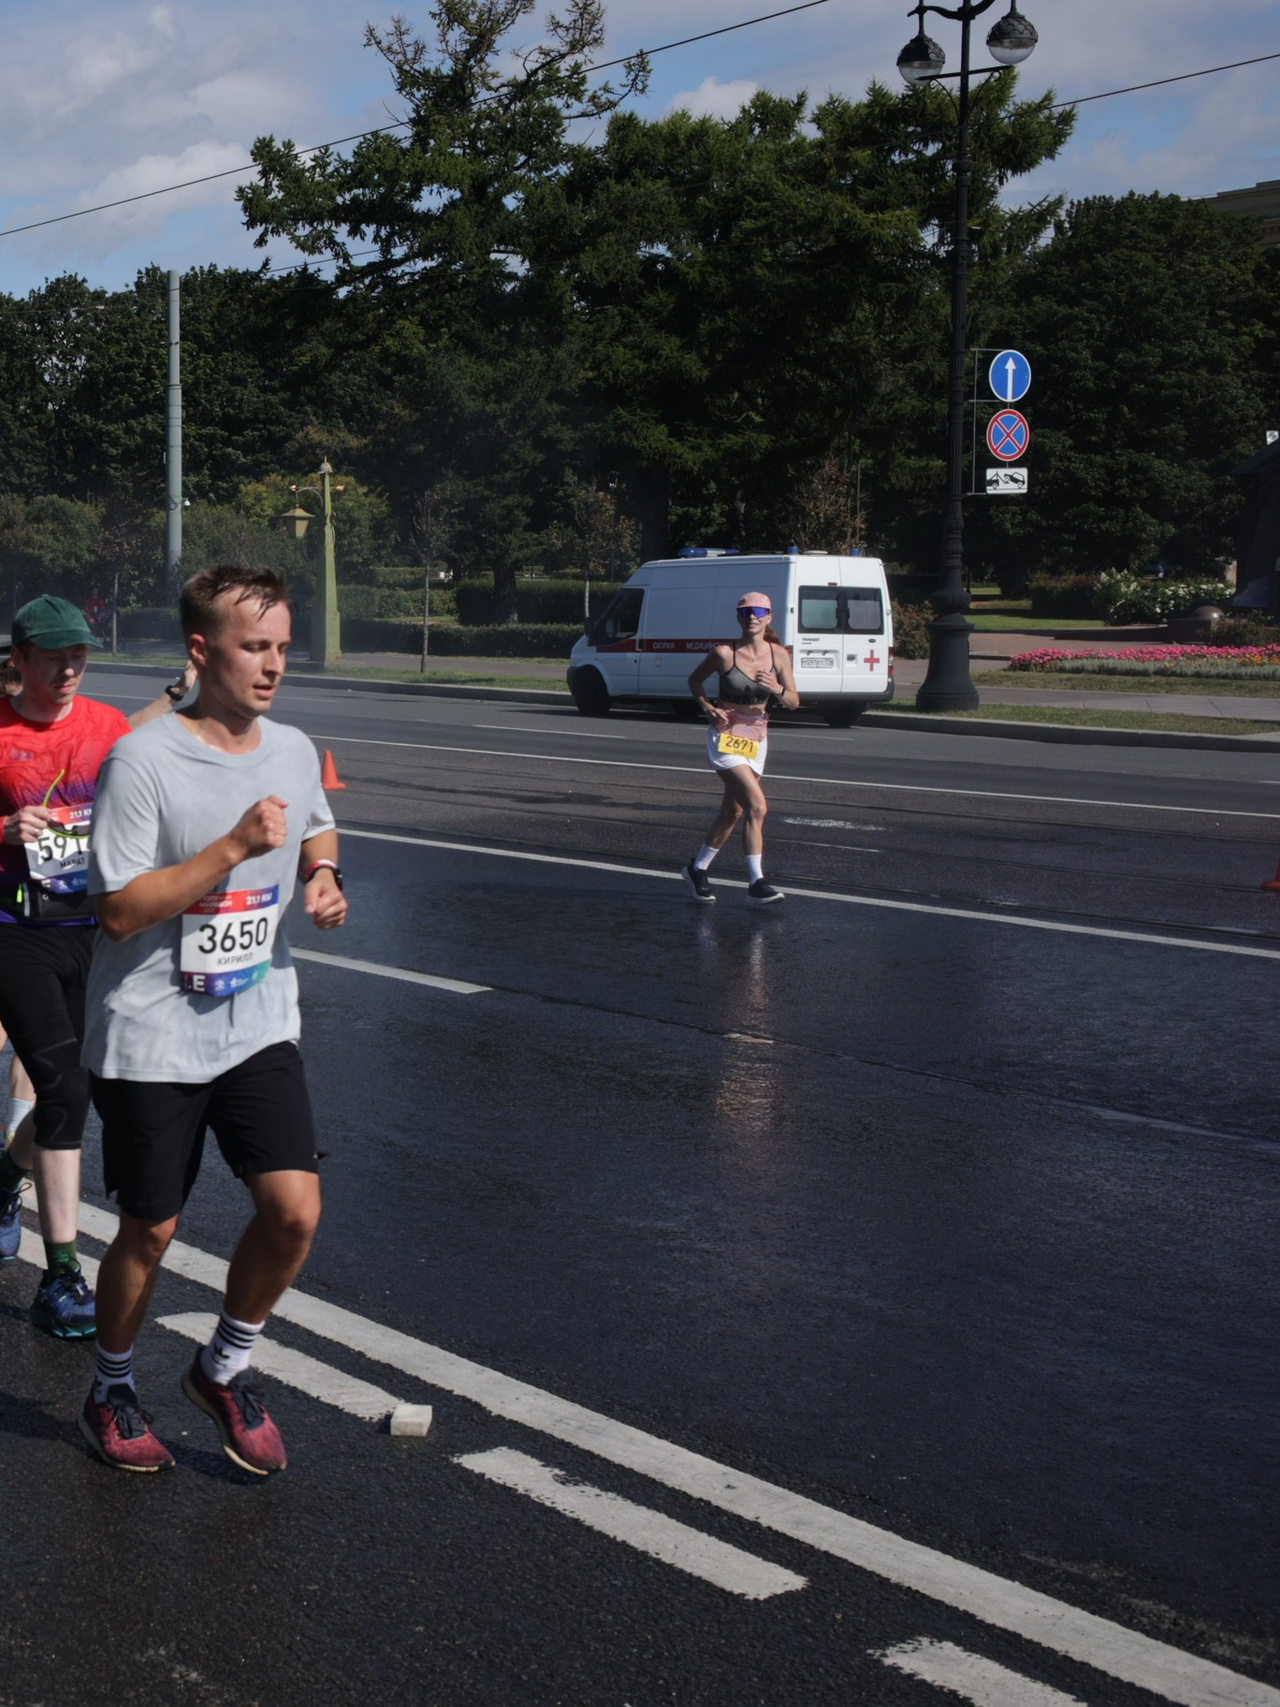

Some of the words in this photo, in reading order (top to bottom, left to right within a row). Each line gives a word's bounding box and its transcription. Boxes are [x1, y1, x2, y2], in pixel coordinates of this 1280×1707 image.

[725, 735, 754, 753] 2671
[60, 857, 86, 868] МАРАТ
[198, 917, 268, 954] 3650
[217, 952, 253, 966] КИРИЛЛ
